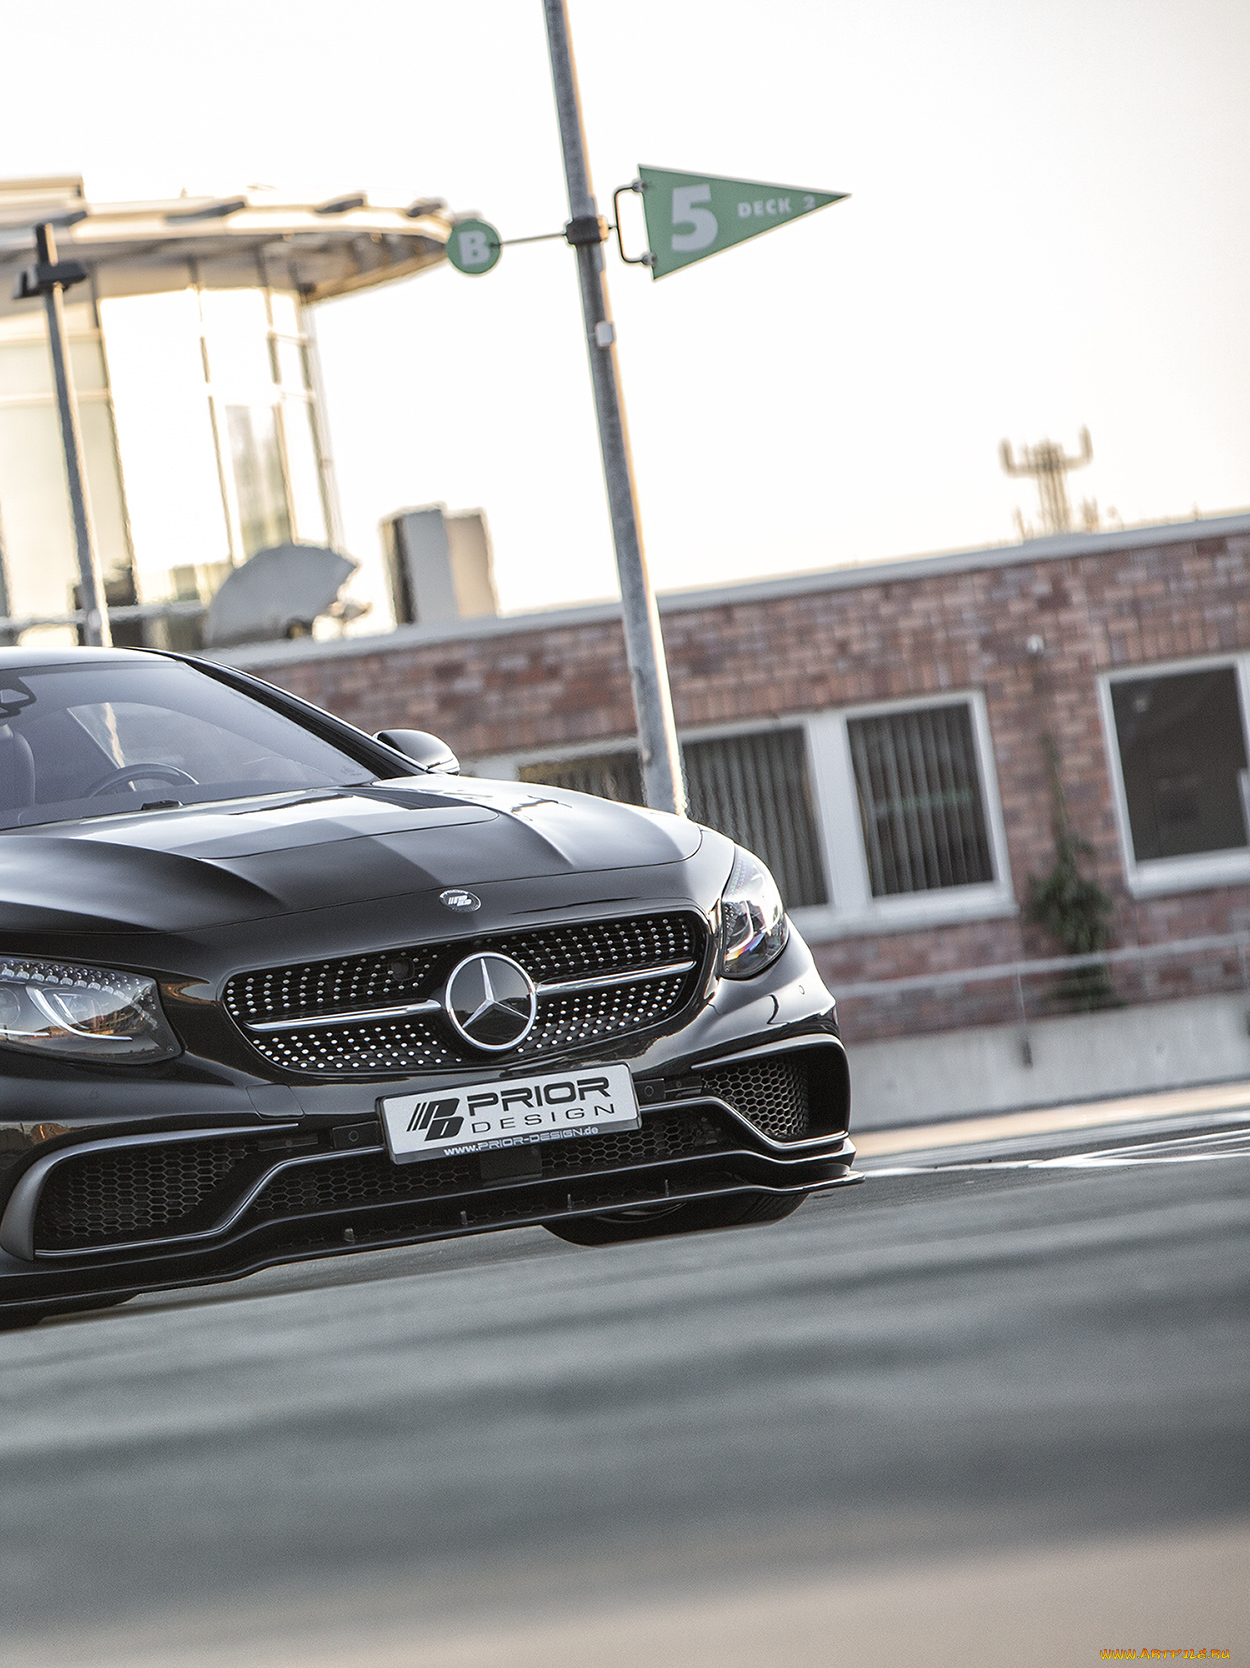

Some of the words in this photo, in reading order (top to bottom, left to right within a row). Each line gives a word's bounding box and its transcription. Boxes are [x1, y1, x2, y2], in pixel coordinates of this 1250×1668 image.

[671, 183, 719, 253] 5
[738, 197, 792, 218] DECK
[459, 230, 490, 266] B
[466, 1076, 611, 1116] PRIOR
[471, 1103, 615, 1134] DESIGN
[444, 1126, 599, 1156] www.PRIOR-DESIGN.de
